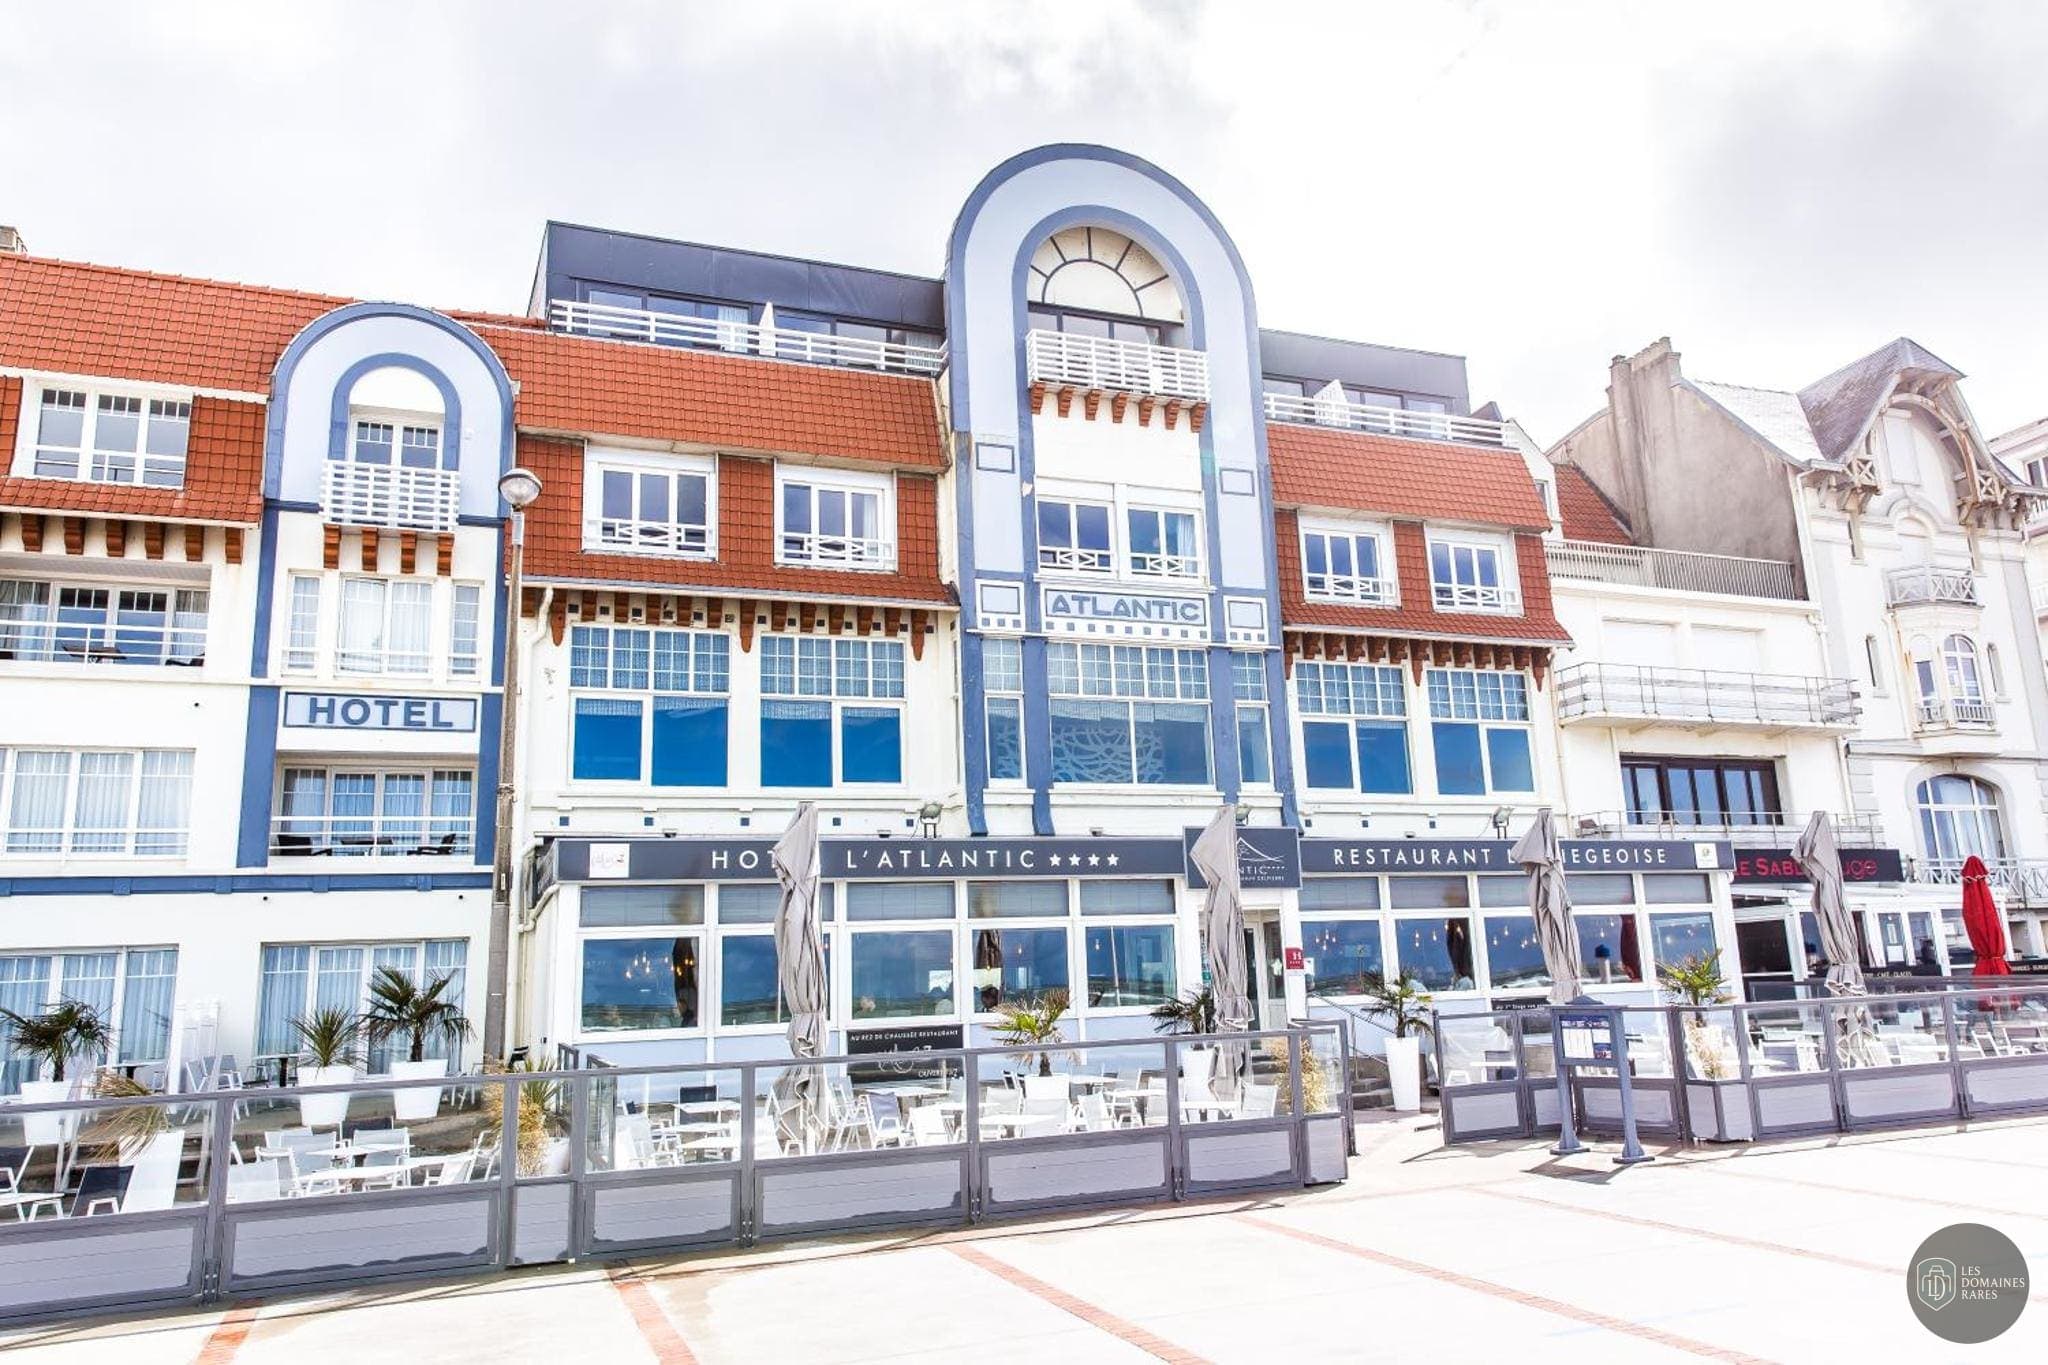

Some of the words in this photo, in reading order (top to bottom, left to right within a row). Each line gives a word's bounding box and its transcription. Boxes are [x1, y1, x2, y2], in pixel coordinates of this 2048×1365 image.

[1052, 594, 1200, 621] ATLANTIC
[308, 697, 453, 727] HOTEL
[711, 850, 776, 869] HOT
[847, 850, 1034, 868] L'ATLANTIC
[1333, 848, 1491, 865] RESTAURANT
[1561, 848, 1667, 864] IEGEOISE
